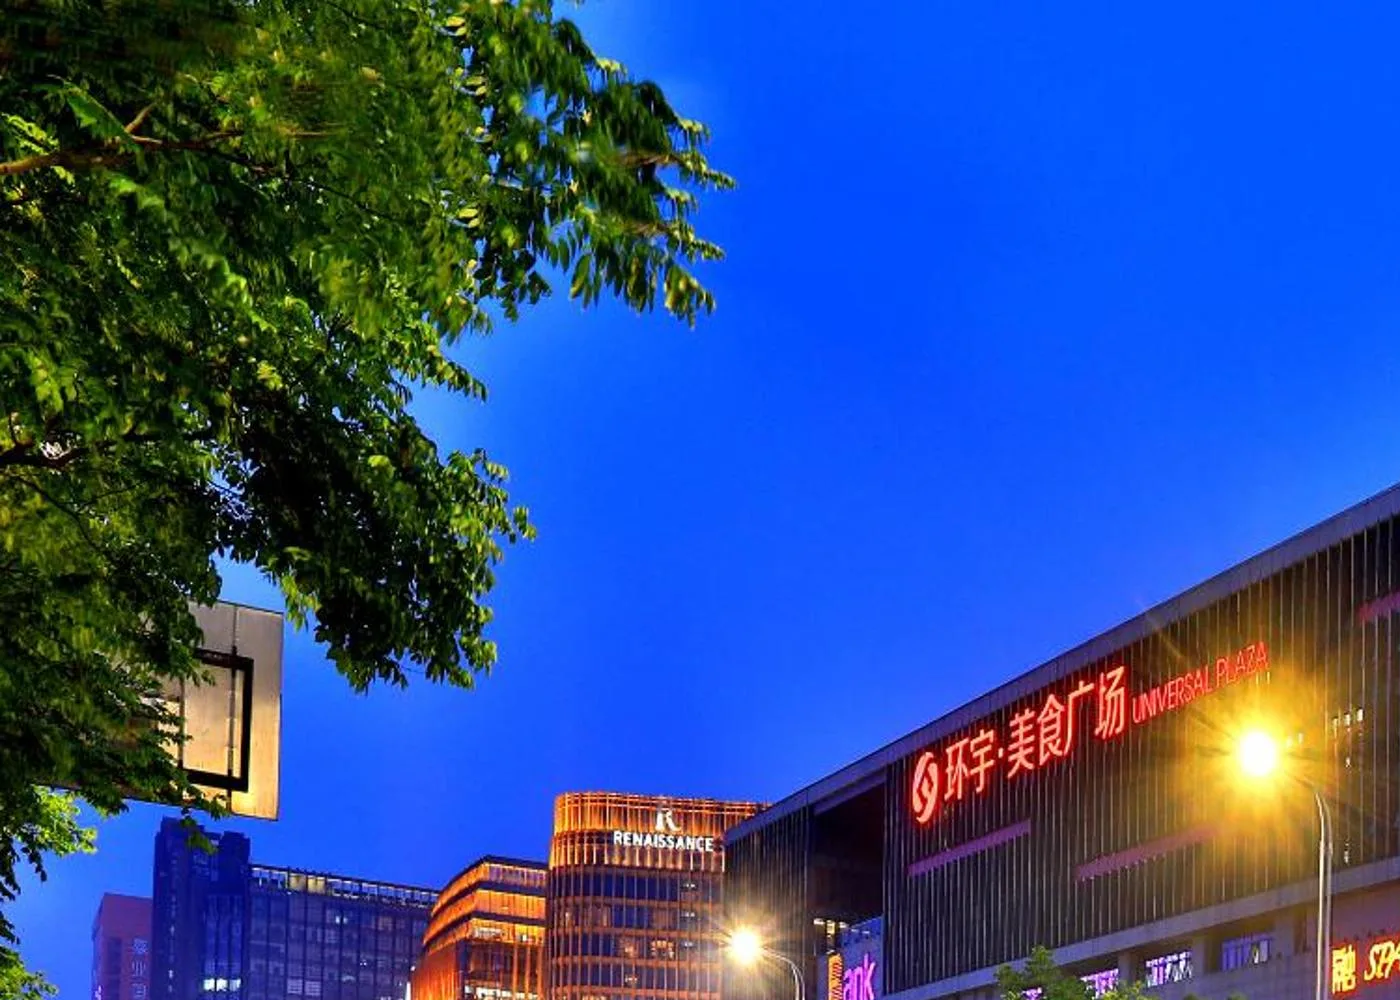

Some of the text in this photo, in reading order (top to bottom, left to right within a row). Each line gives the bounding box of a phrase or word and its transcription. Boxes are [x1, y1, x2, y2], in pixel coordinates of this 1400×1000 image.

[1132, 664, 1213, 724] UNIVERSAL
[1215, 640, 1270, 689] PLAZA
[613, 830, 714, 852] RENAISSANCE
